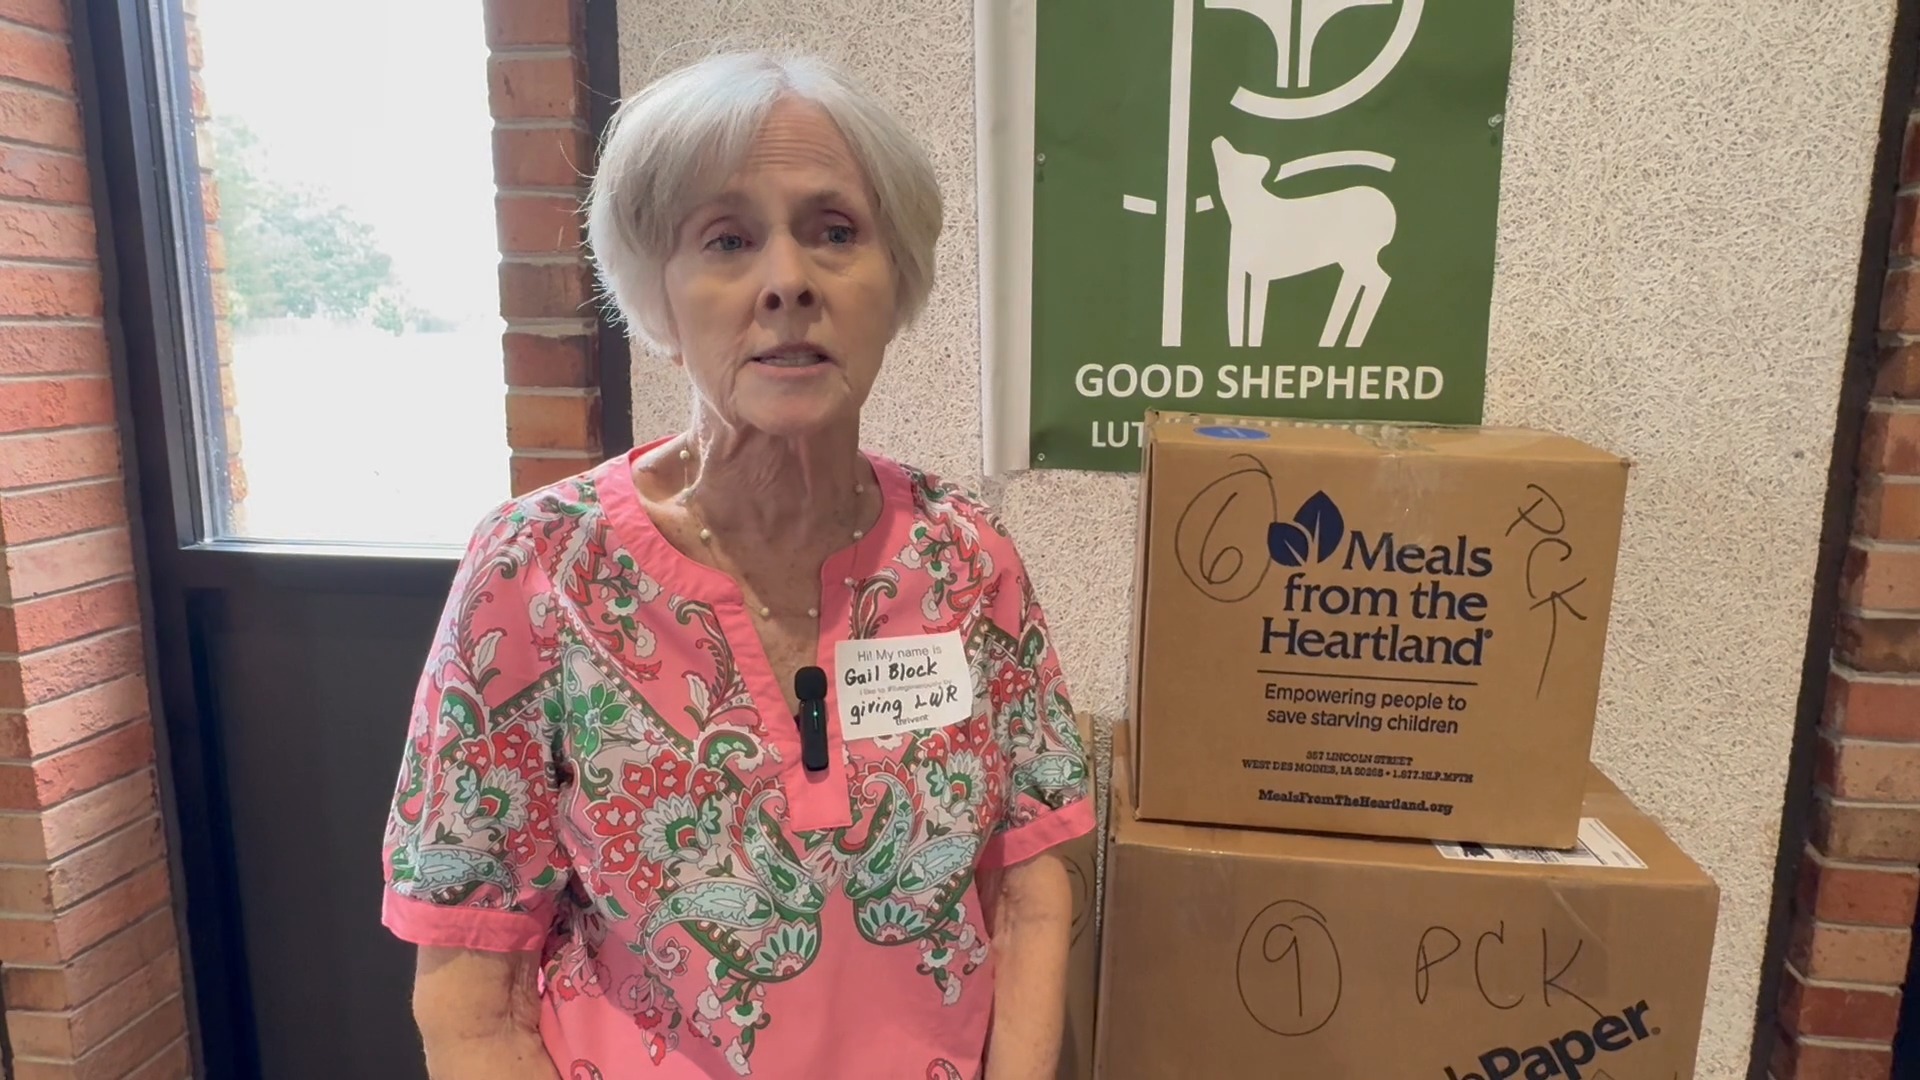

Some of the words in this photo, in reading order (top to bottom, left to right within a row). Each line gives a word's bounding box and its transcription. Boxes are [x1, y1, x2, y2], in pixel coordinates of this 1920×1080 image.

[1074, 362, 1204, 399] GOOD
[1216, 364, 1444, 401] SHEPHERD
[1199, 492, 1243, 585] 6
[1342, 530, 1493, 578] Meals
[1283, 572, 1398, 617] from
[1410, 580, 1488, 622] the
[857, 650, 873, 662] Hi!
[875, 648, 894, 663] My
[897, 647, 929, 659] name
[932, 644, 942, 655] is
[844, 665, 880, 687] Gail
[888, 656, 938, 681] Block
[850, 697, 903, 726] giving
[914, 684, 959, 710] LWR
[1264, 683, 1376, 707] Empowering
[1381, 692, 1443, 711] people
[1447, 694, 1467, 711] to
[1267, 709, 1307, 725] save
[1311, 710, 1382, 732] starving
[1387, 714, 1458, 734] children
[1242, 759, 1271, 770] WEST
[1272, 761, 1293, 772] DES
[1325, 752, 1373, 765] LINCOLN
[1373, 755, 1414, 767] STREET
[1258, 788, 1454, 816] MealsFromTheHeartland.org
[1414, 920, 1606, 1018] PCK
